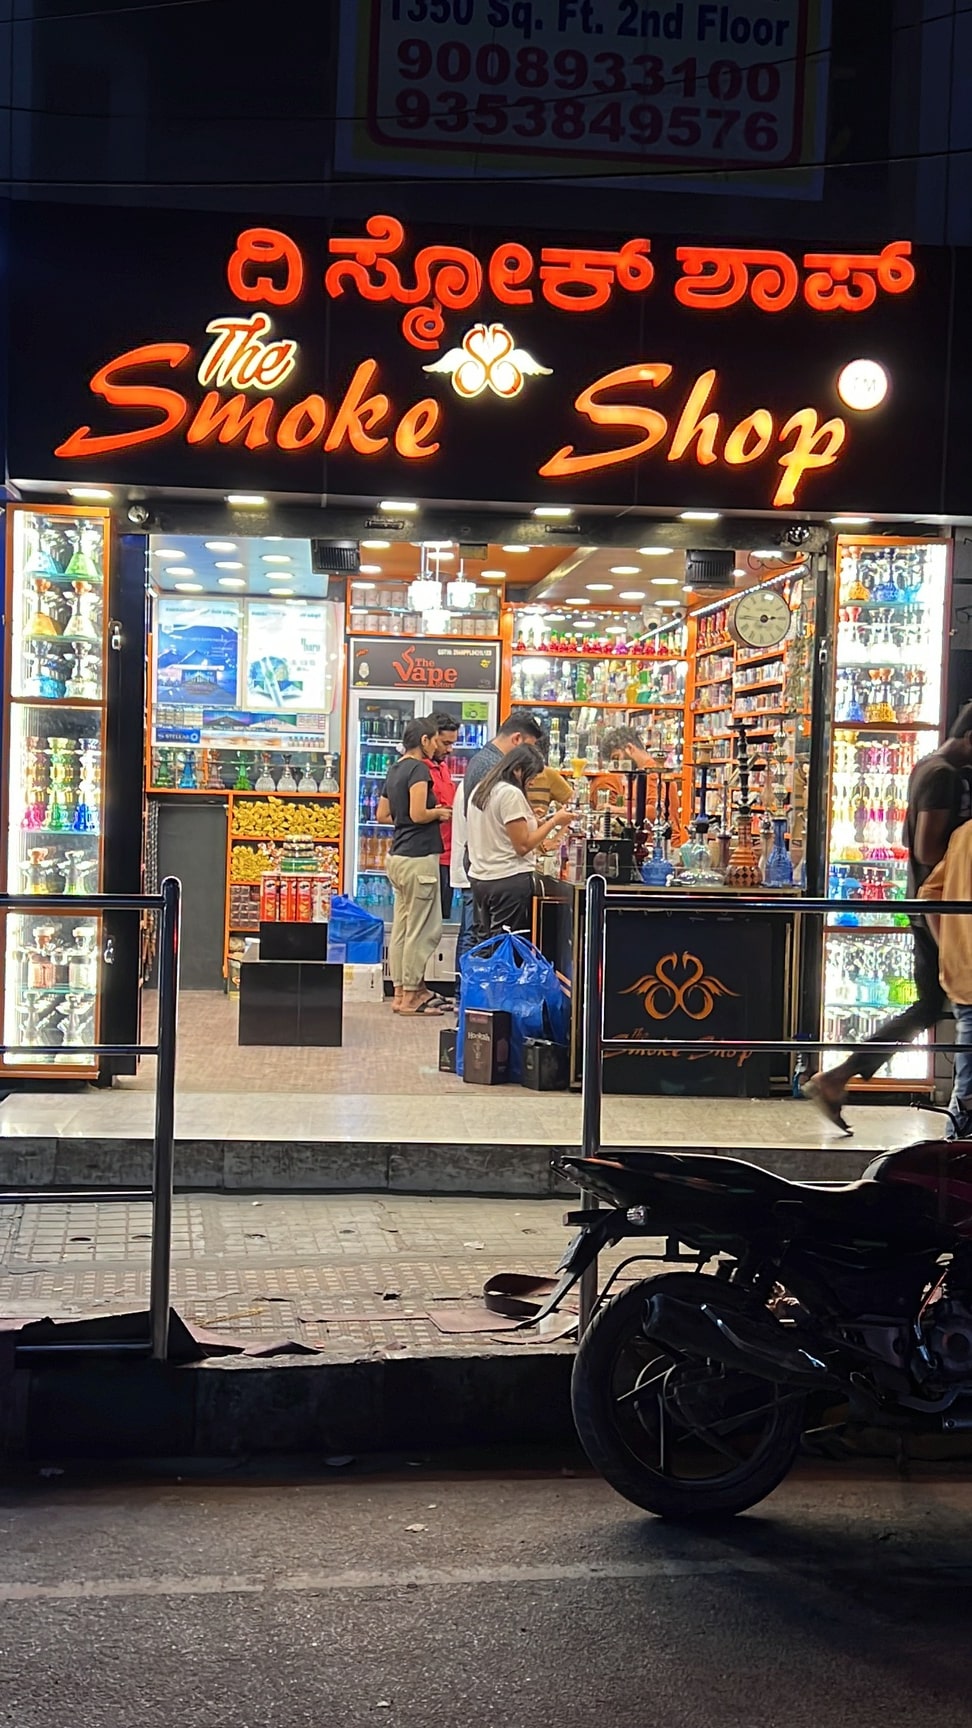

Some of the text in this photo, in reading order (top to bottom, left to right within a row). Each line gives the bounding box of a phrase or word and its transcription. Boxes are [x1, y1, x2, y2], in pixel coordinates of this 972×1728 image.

[487, 0, 543, 39] Sq.
[557, 0, 604, 35] Ft.
[618, 0, 682, 40] 2nd
[697, 8, 790, 47] Floor
[397, 38, 781, 103] 9008933100
[395, 88, 779, 152] 9353849576
[228, 215, 916, 350] ದಿ ಸ್ಮೋಕ್ ಶಾಪ್
[197, 311, 300, 394] The
[54, 342, 846, 507] Smoke Shop
[392, 644, 458, 688] Vape
[414, 657, 435, 667] The
